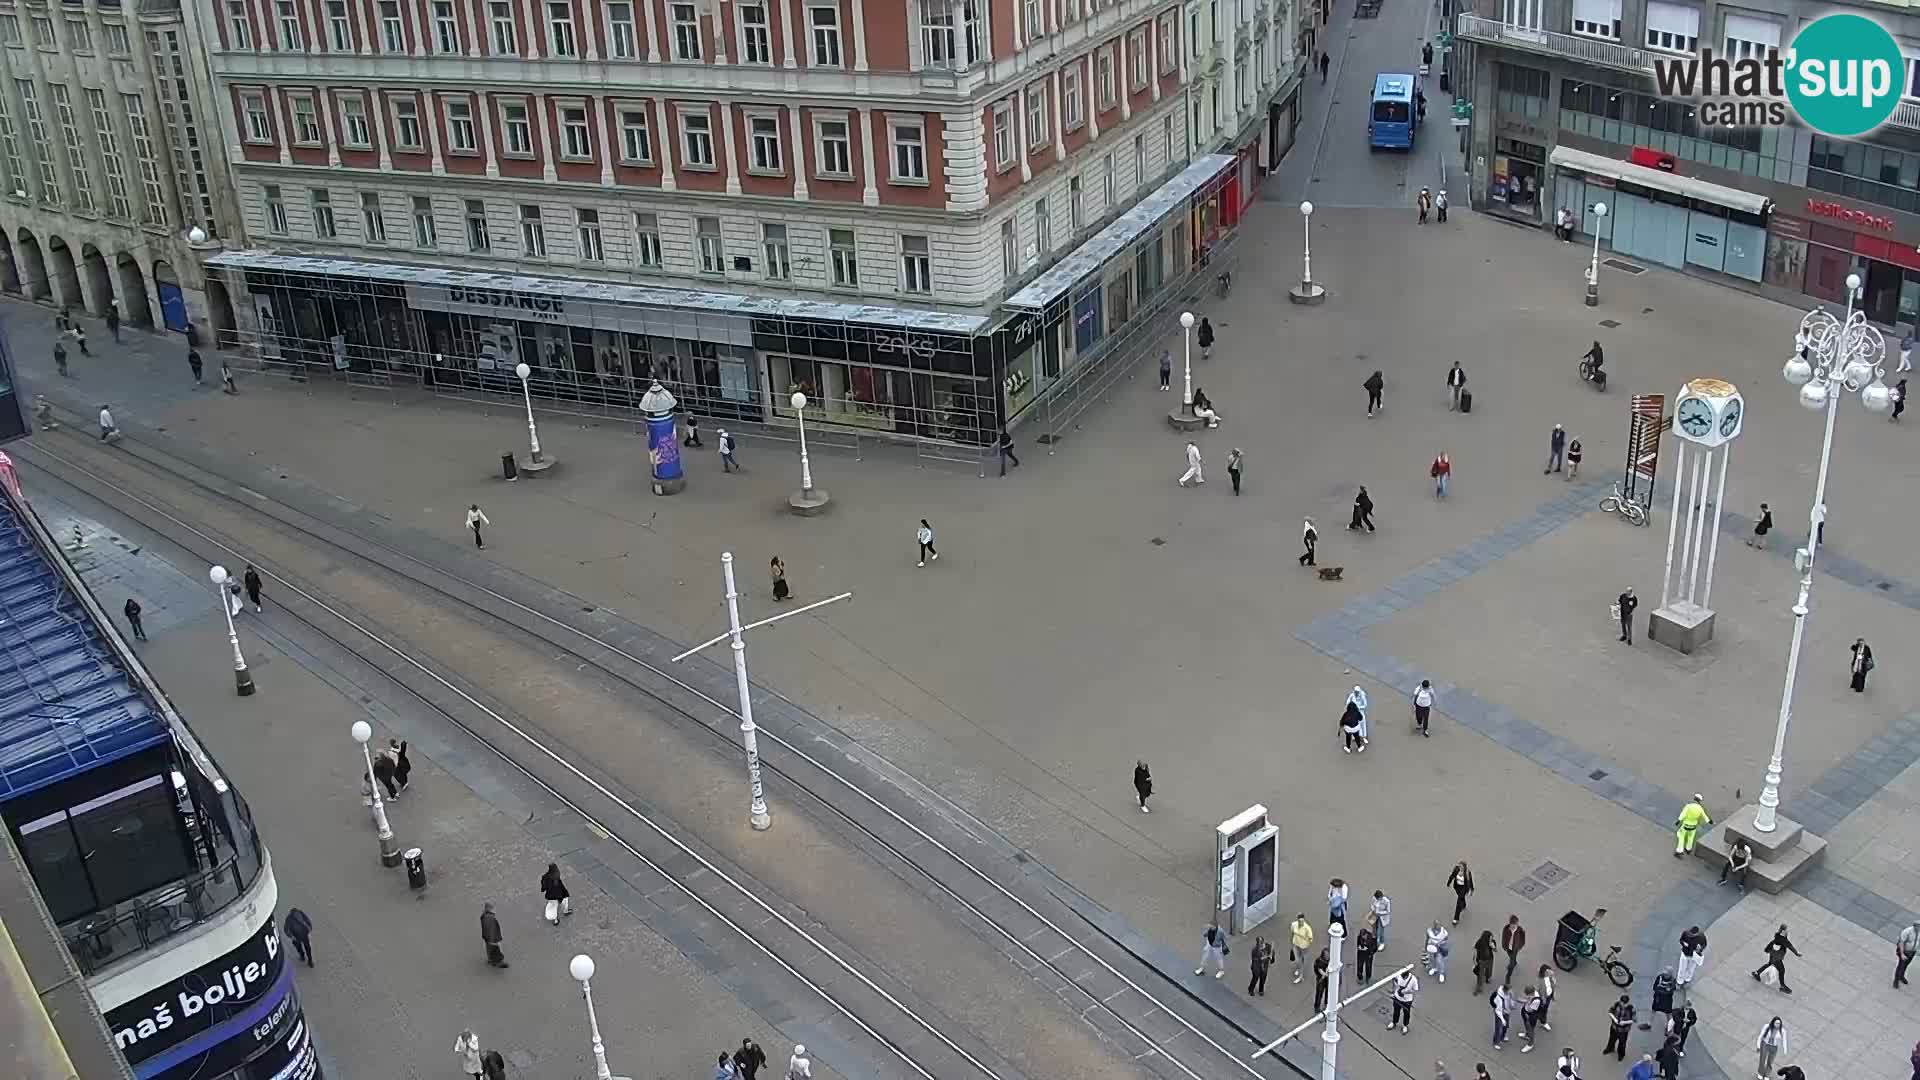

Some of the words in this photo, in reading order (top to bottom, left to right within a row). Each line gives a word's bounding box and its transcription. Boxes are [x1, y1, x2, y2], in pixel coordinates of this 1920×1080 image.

[451, 286, 564, 313] DESSANGE
[113, 1002, 174, 1049] naš
[178, 961, 267, 1018] bolje,
